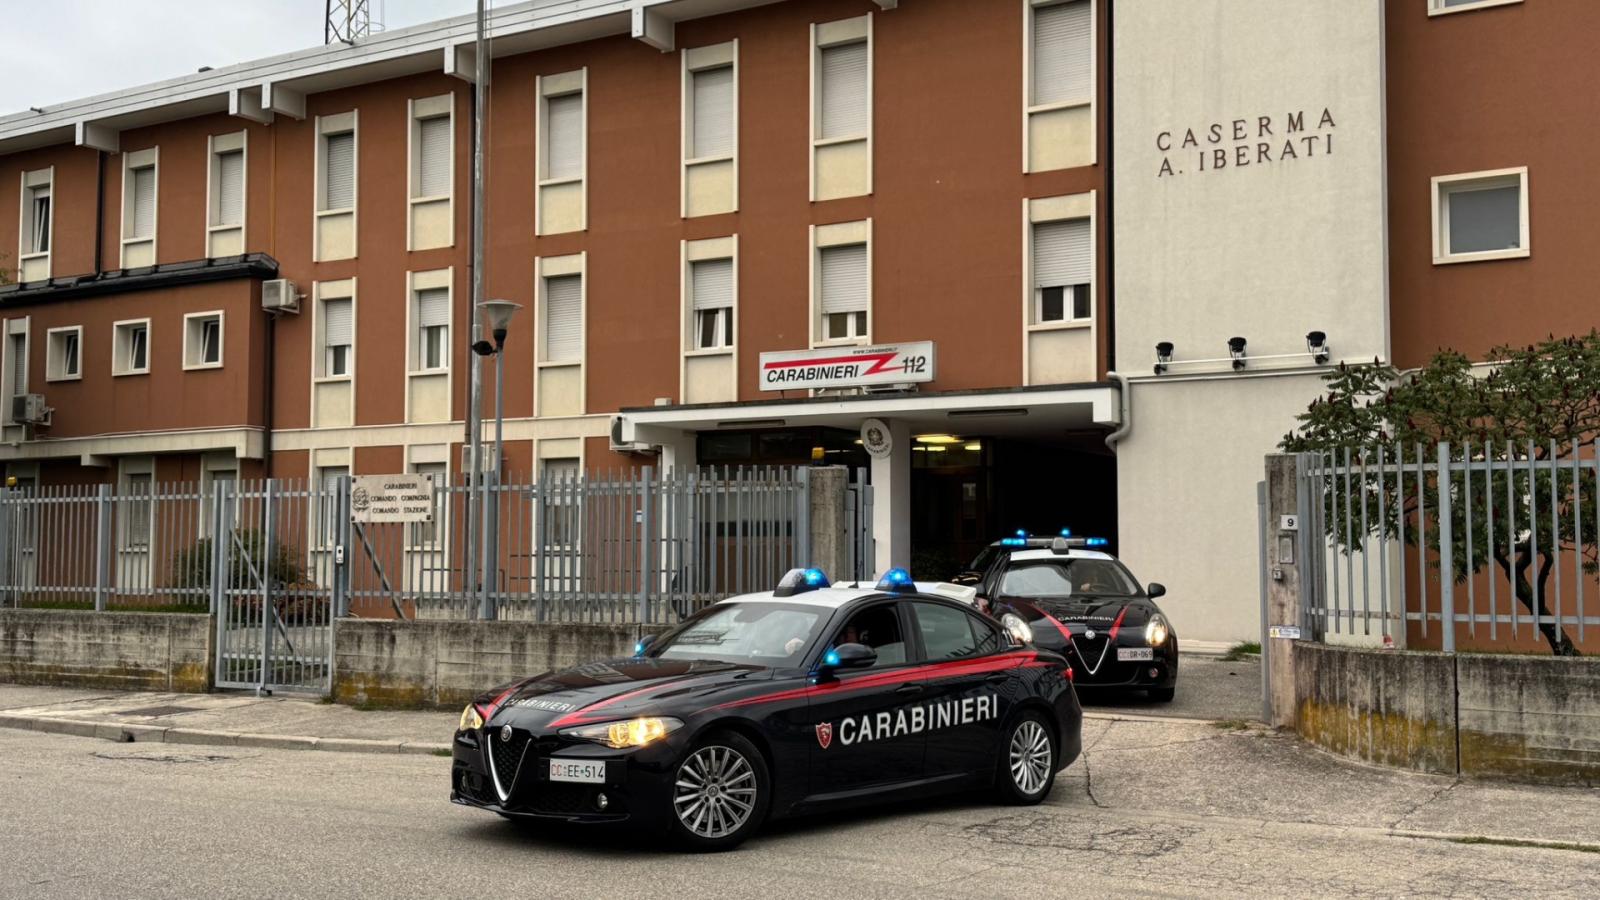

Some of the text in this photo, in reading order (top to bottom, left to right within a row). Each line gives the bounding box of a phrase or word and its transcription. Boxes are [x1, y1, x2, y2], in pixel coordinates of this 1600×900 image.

[1156, 107, 1336, 151] CASERMA
[1157, 133, 1333, 177] A. IBERATI
[766, 355, 926, 383] CARABINIERI 112
[403, 506, 429, 514] STAZIONE
[1287, 518, 1295, 527] 9
[1057, 614, 1115, 622] CARABINIERI
[504, 698, 577, 713] CARABINIERI
[839, 694, 998, 746] CARABINIERI
